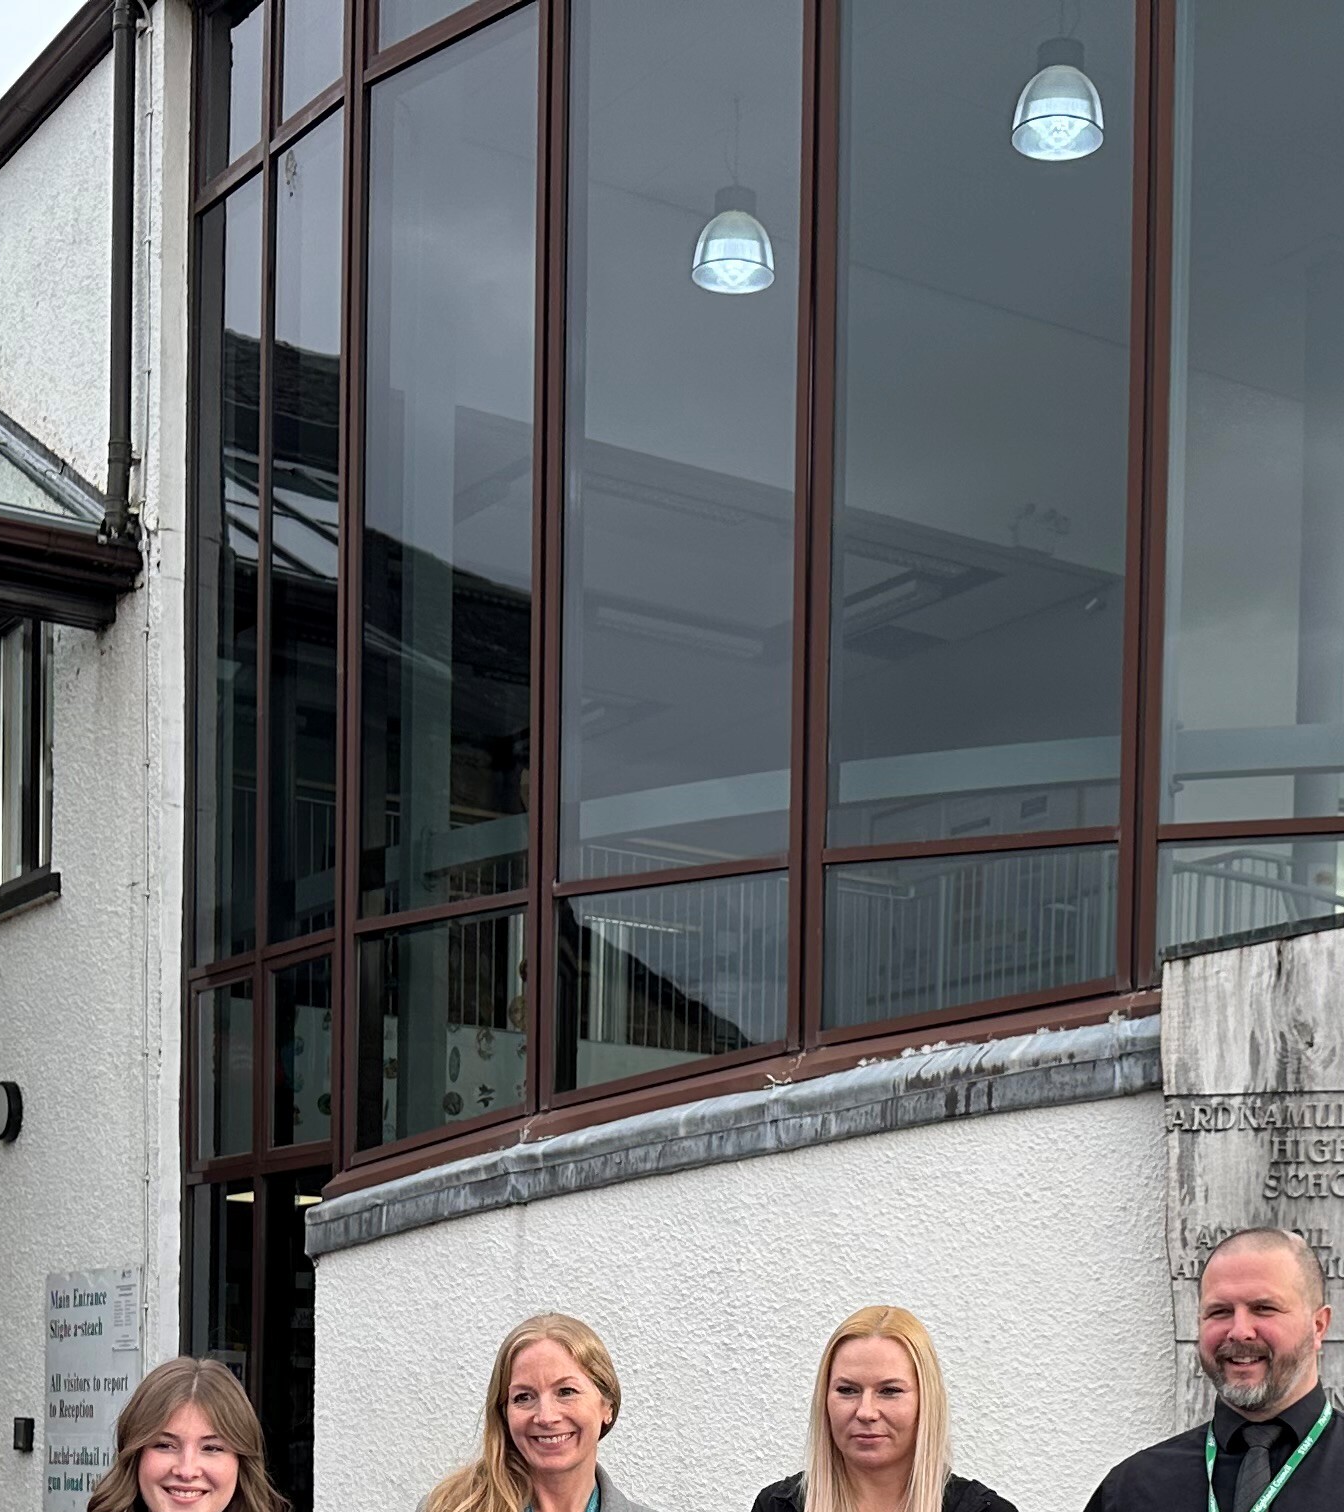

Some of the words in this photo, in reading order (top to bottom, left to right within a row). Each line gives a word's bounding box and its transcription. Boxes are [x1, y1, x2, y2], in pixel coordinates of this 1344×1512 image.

[50, 1289, 70, 1309] Main
[73, 1288, 107, 1307] Entrance
[50, 1319, 71, 1342] Slighe
[74, 1316, 103, 1337] a-steach
[50, 1372, 62, 1392] All
[64, 1372, 91, 1392] visitors
[93, 1375, 101, 1392] to
[104, 1373, 129, 1396] report
[49, 1402, 57, 1418] to
[59, 1399, 94, 1423] Reception
[1255, 1484, 1276, 1512] Highland
